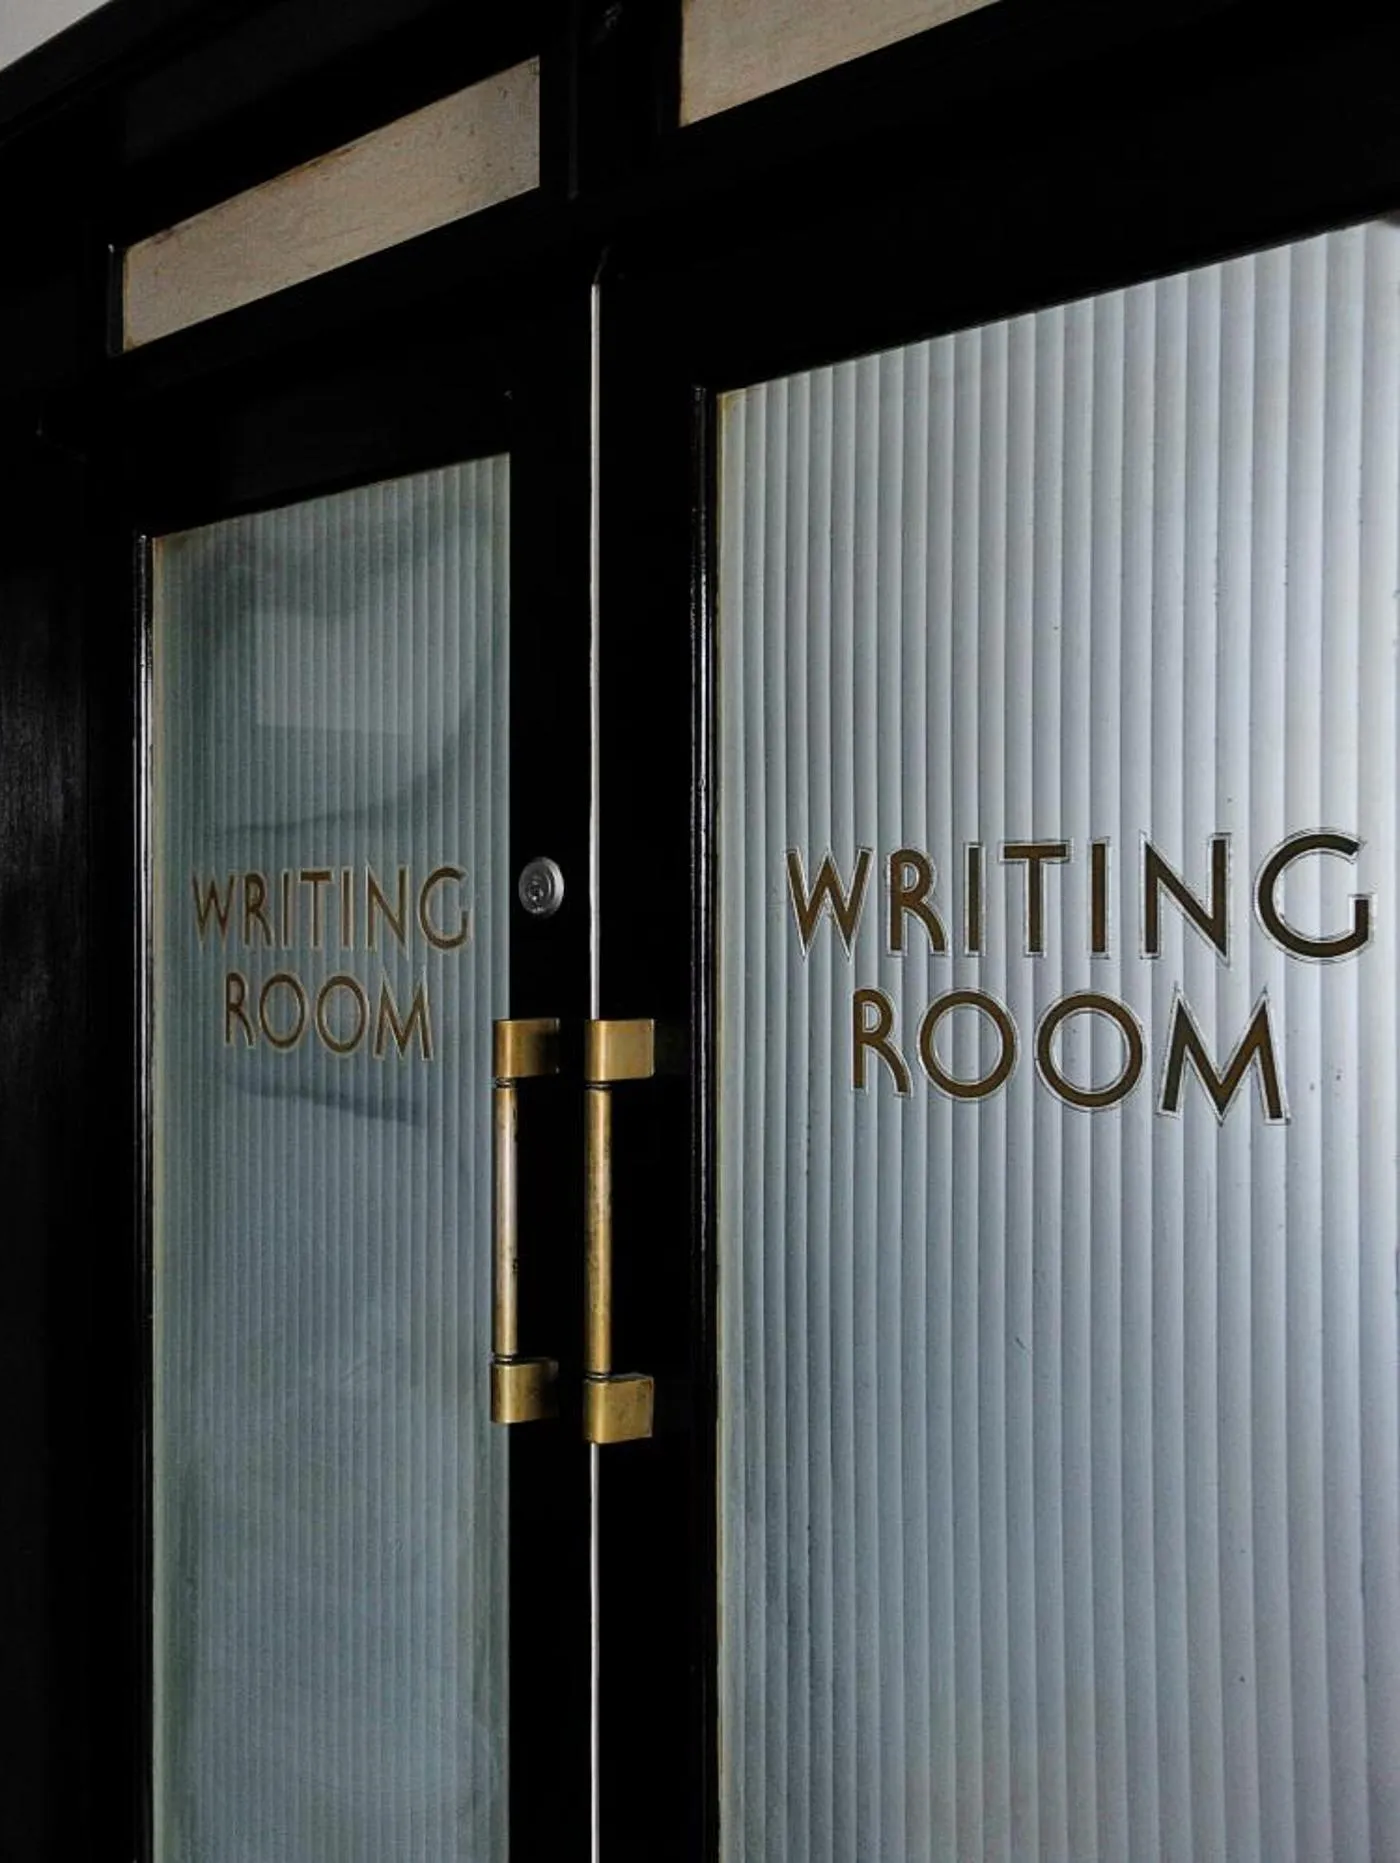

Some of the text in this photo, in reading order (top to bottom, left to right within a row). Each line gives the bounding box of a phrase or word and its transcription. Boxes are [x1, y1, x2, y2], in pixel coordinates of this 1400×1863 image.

[190, 861, 473, 959] WRITING
[784, 826, 1377, 968] WRITING
[222, 965, 434, 1062] ROOM
[852, 980, 1292, 1128] ROOM
